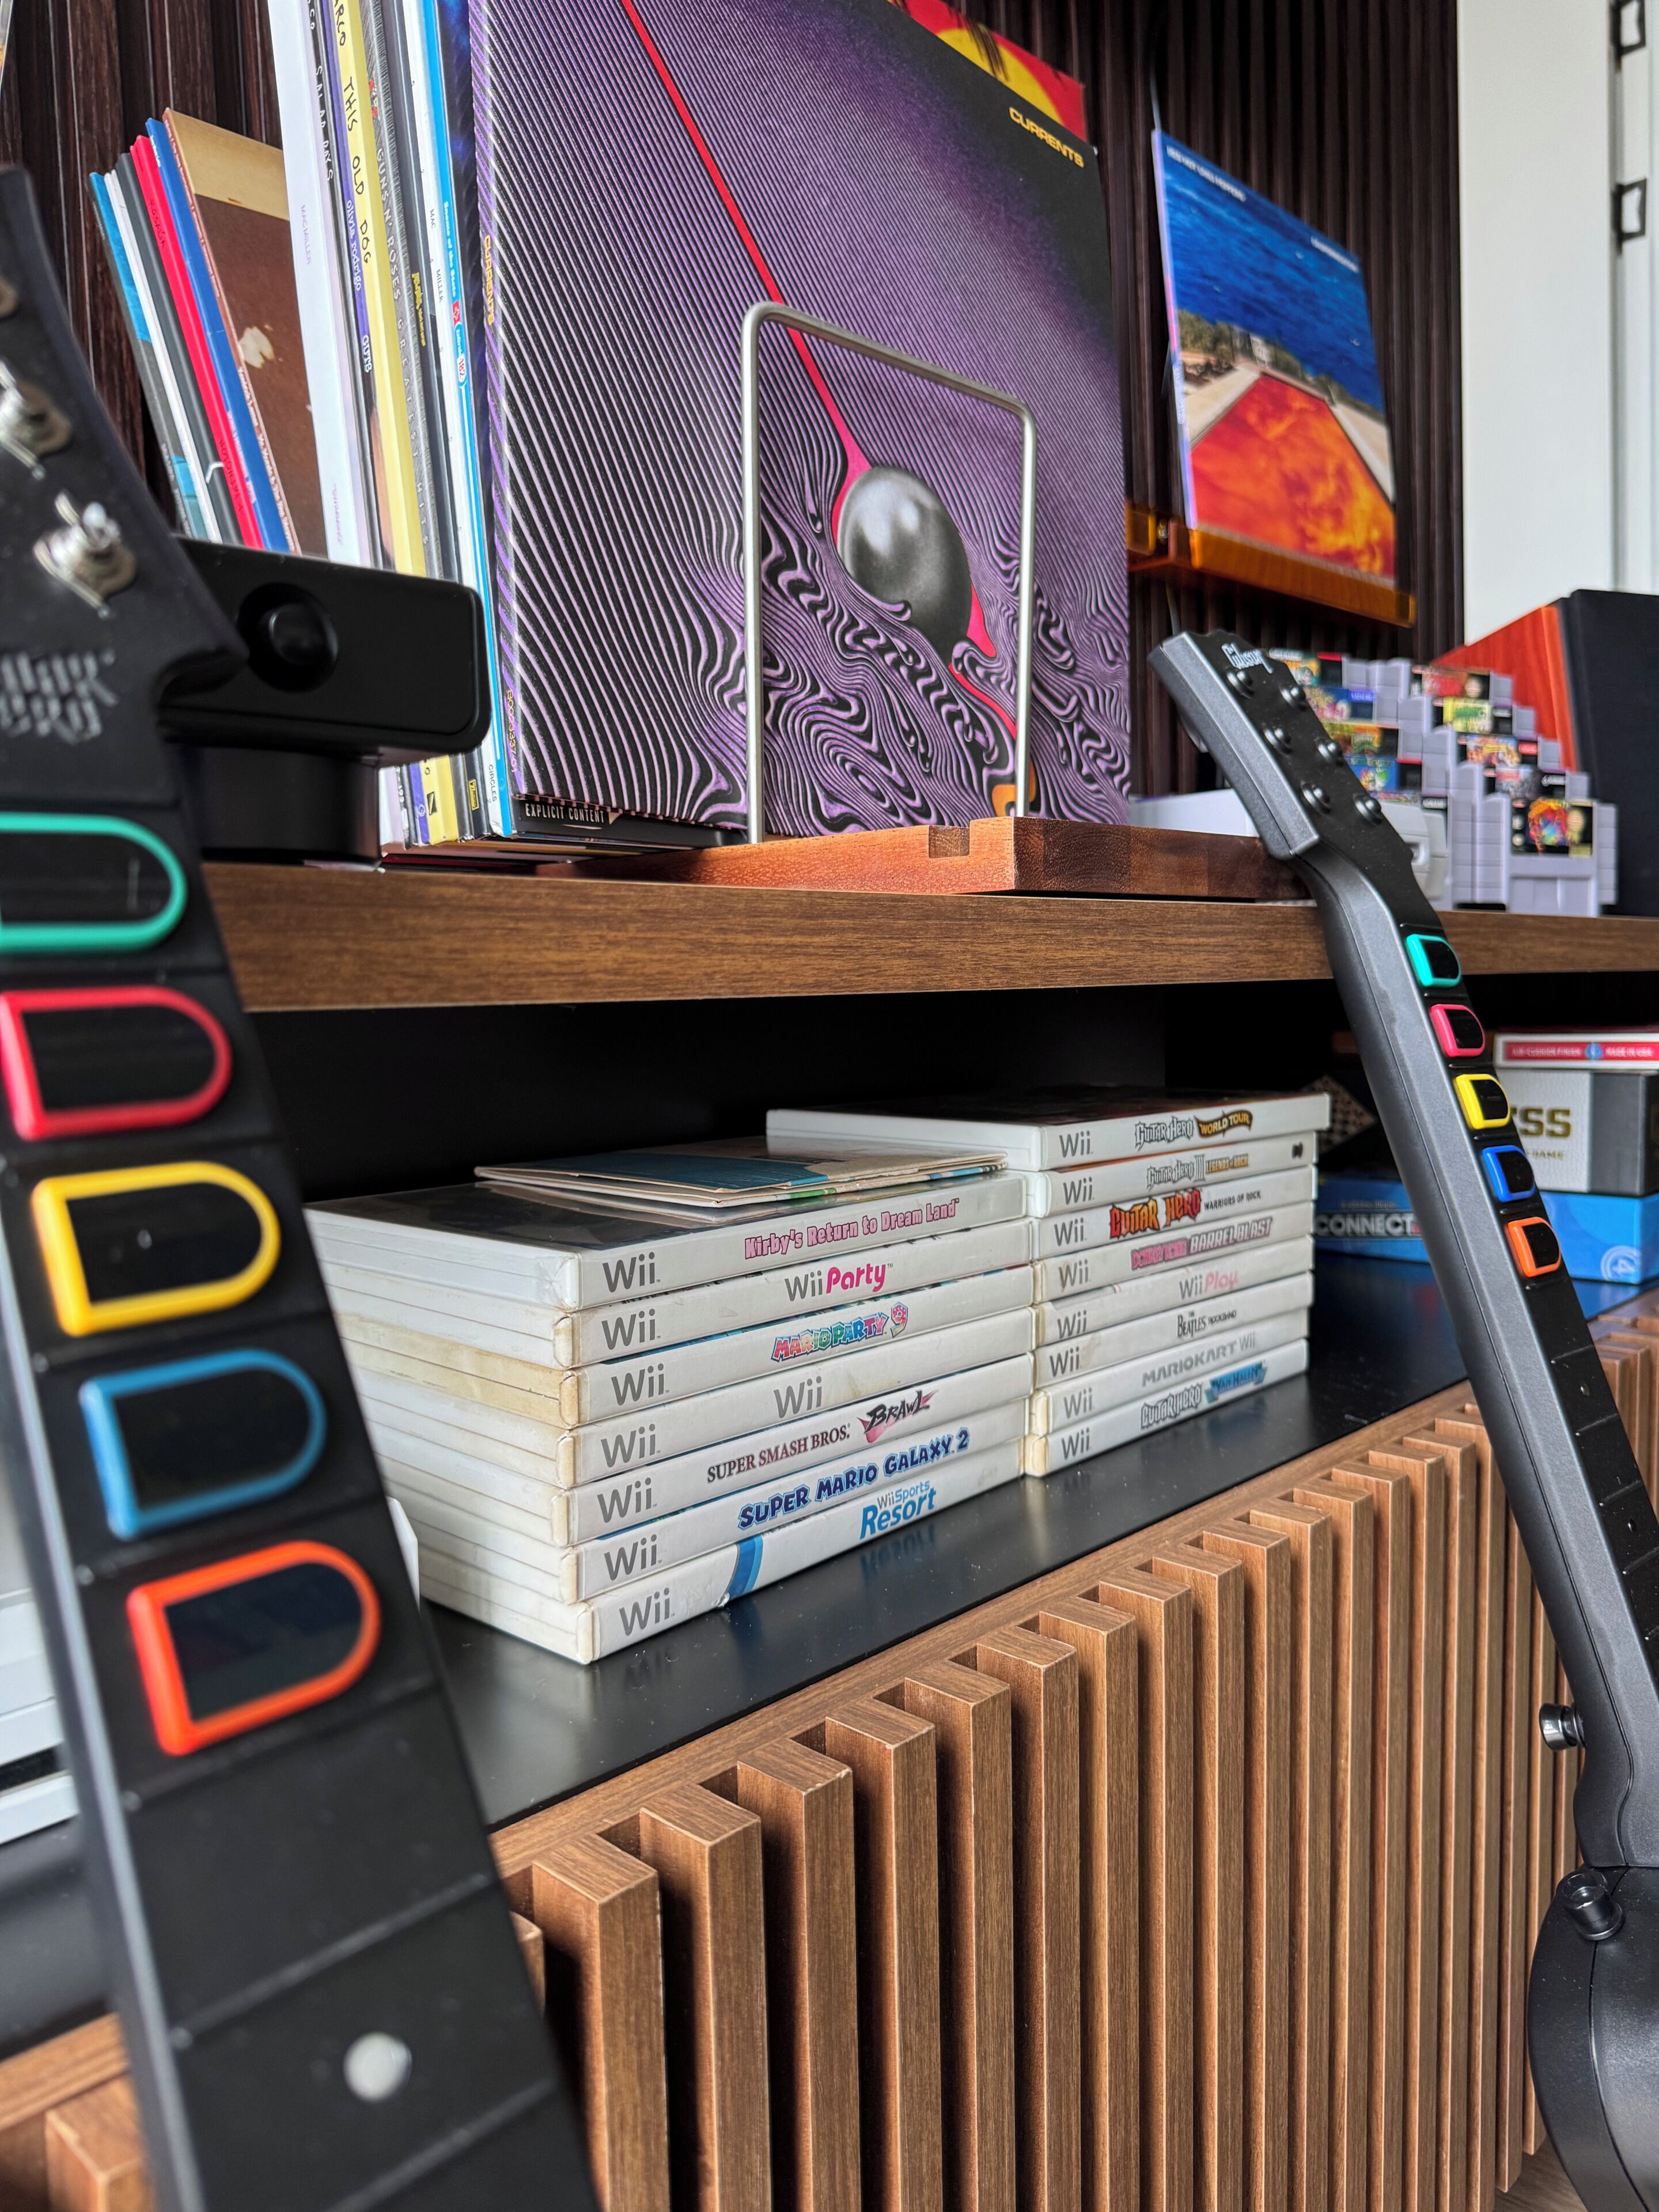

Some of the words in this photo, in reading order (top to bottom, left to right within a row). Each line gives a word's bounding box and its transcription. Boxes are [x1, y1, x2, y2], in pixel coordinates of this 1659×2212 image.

[316, 66, 325, 128] SALAD
[323, 140, 333, 180] DAYS
[1009, 107, 1084, 168] CURRENTS
[344, 77, 358, 131] THIS
[352, 156, 364, 195] OLD
[360, 219, 372, 263] DOG
[347, 200, 355, 239] olivia
[351, 241, 361, 290] rodrigo
[362, 335, 373, 373] GUTS
[484, 234, 494, 325] CURRENTS
[377, 148, 389, 200] GUNS
[387, 236, 400, 300] ROSES
[397, 319, 419, 457] GREATEST
[416, 483, 428, 544] HITS
[436, 269, 444, 302] MILLER
[488, 764, 498, 802] CIRCLES
[1221, 642, 1273, 674] Gibson
[525, 805, 565, 819] EXPLICIT
[568, 808, 605, 824] CONTENT
[1059, 1130, 1091, 1158] Wii
[1135, 1121, 1166, 1151] GUITAR
[1166, 1116, 1194, 1143] HERO
[1199, 1119, 1228, 1135] WORLD
[1229, 1113, 1250, 1127] TOUR
[1054, 1217, 1084, 1246] Wii
[1109, 1195, 1160, 1239] GUITAR
[1163, 1187, 1202, 1228] HERO
[1204, 1196, 1235, 1211] WARRIORS
[1237, 1193, 1244, 1202] OF
[1246, 1190, 1261, 1201] ROCK
[1063, 1176, 1093, 1205] Wii
[1147, 1165, 1172, 1191] GUITAR
[1172, 1159, 1194, 1184] HERO
[1206, 1157, 1229, 1174] LEGENDS
[603, 1252, 655, 1293] Wii
[745, 1229, 803, 1259] Kirby's
[807, 1221, 858, 1247] Return
[862, 1215, 878, 1235] to
[881, 1209, 923, 1232] Dream
[926, 1199, 956, 1223] Land
[1058, 1259, 1088, 1289] Wii
[1131, 1246, 1164, 1270] DONKEY
[1164, 1237, 1188, 1262] KONG
[1189, 1226, 1238, 1254] BARREL
[1237, 1217, 1272, 1241] BLAST
[1315, 1213, 1415, 1236] CONNECT
[601, 1308, 655, 1350] Wii
[611, 1363, 664, 1406] Wii
[890, 1301, 908, 1338] 9
[1050, 1346, 1079, 1377] Wii
[1177, 1314, 1207, 1338] BEATLES
[1057, 1309, 1086, 1339] Wii
[1063, 1387, 1093, 1418] Wii
[1239, 1331, 1256, 1351] Wii
[597, 1478, 652, 1523] Wii
[707, 1453, 756, 1483] SUPER
[759, 1437, 807, 1467] SMASH
[810, 1426, 850, 1451] BROS.
[865, 1390, 929, 1433] BRAWL
[601, 1424, 656, 1467] Wii
[774, 1376, 822, 1419] Wii
[1061, 1427, 1090, 1459] Wii
[1141, 1393, 1178, 1430] GUITAR
[1176, 1382, 1203, 1415] HERO
[604, 1534, 657, 1581] Wii
[737, 1484, 812, 1531] SUPER
[815, 1463, 878, 1502] MARIO
[884, 1434, 953, 1478] GALAXY
[956, 1427, 969, 1452] 2
[860, 1487, 936, 1540] Resort
[619, 1588, 670, 1636] Wii
